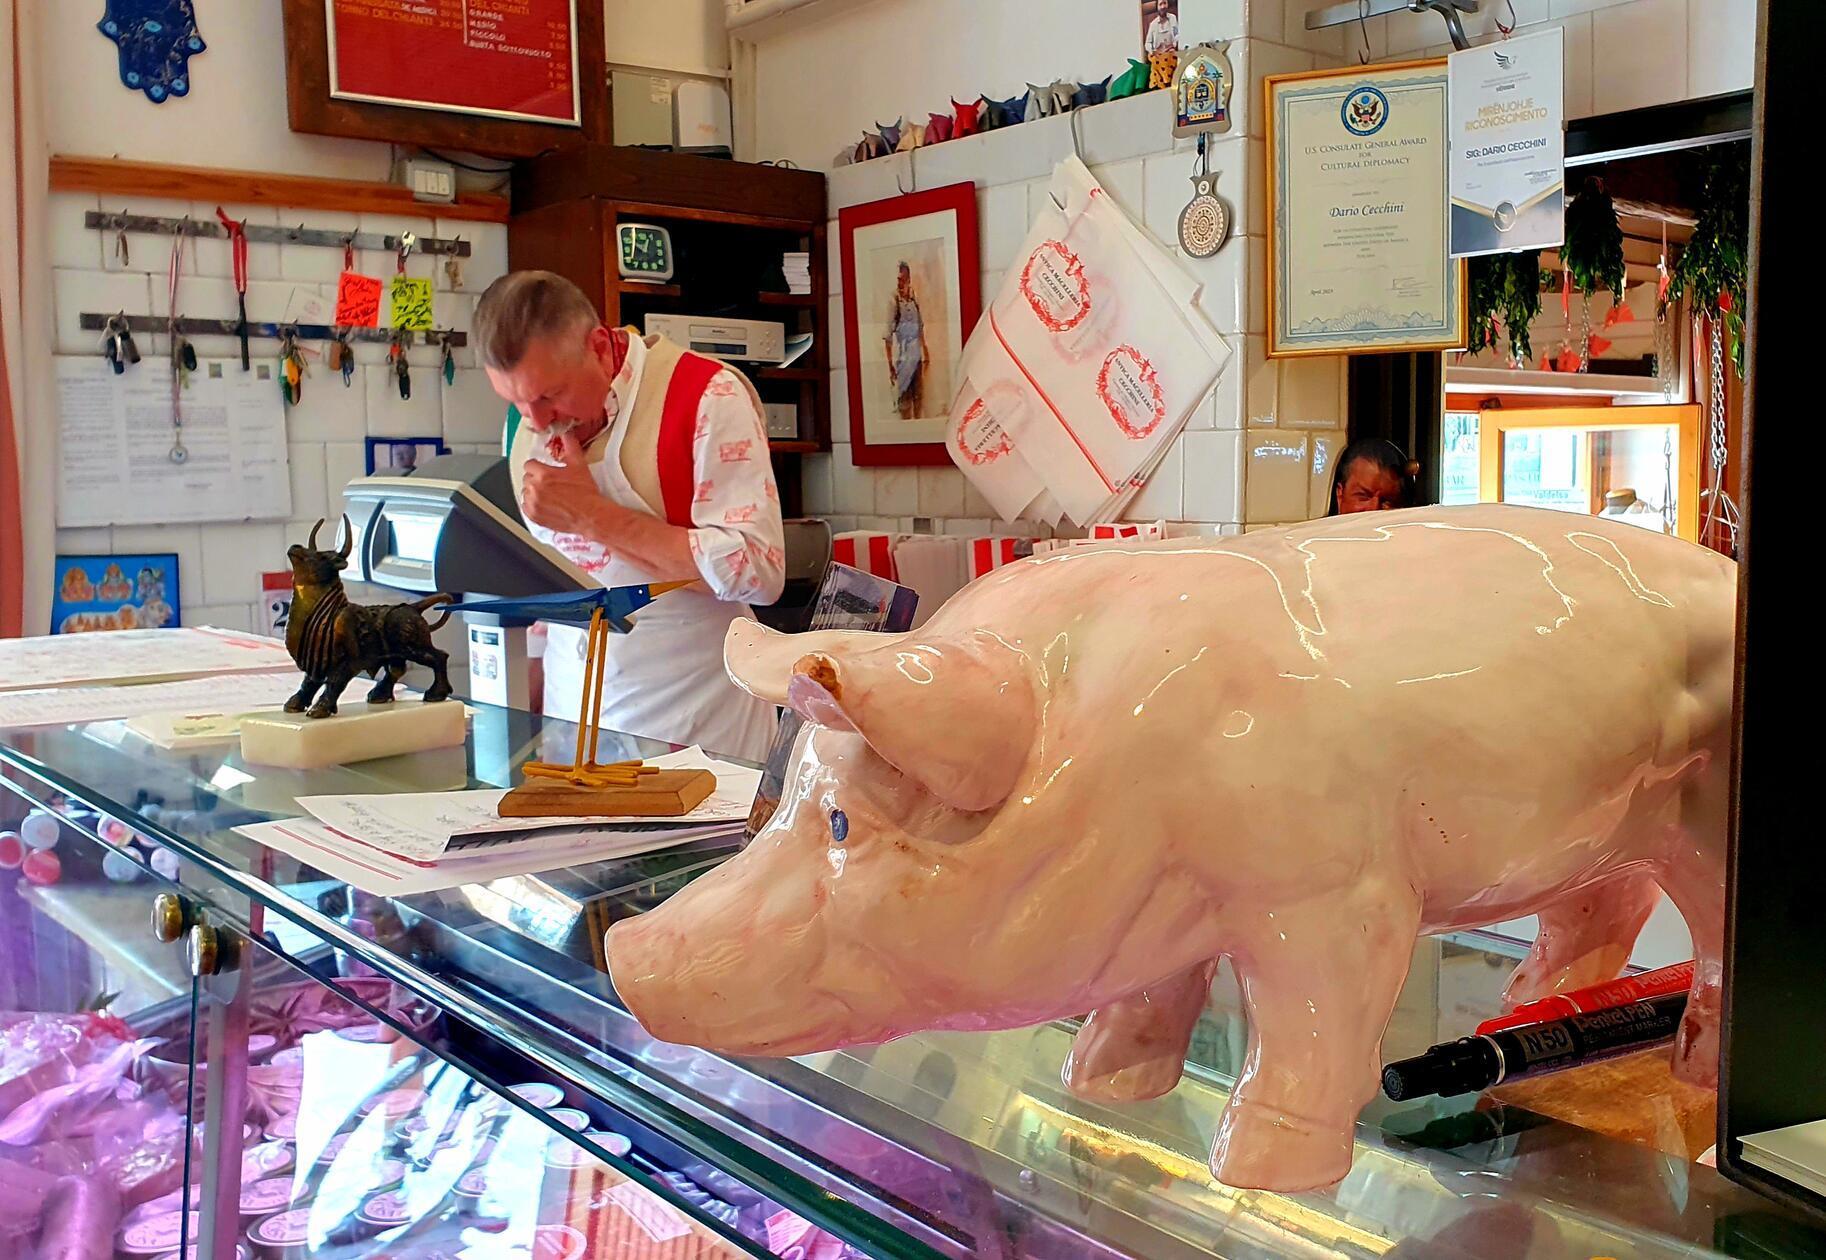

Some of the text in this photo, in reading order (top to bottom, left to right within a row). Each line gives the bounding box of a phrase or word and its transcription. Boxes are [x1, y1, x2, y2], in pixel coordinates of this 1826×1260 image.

[1464, 107, 1548, 132] RICONOSCIMENTO
[1319, 142, 1362, 154] CONSULATE
[1364, 140, 1398, 150] GENERAL
[1399, 137, 1427, 146] AWARD
[1482, 144, 1507, 156] DARIO
[1507, 138, 1547, 152] CECCHINI
[1320, 157, 1410, 171] CULTURAL DIPLOMACY
[1329, 202, 1404, 218] Dario Cecchini
[1041, 272, 1065, 301] CECCHINI
[1053, 271, 1081, 308] MACELLERIA
[1118, 377, 1140, 406] CECCHINI
[1129, 376, 1155, 413] MACELLERIA
[1572, 1001, 1657, 1033] Pentel PEN
[1522, 1027, 1568, 1056] N50
